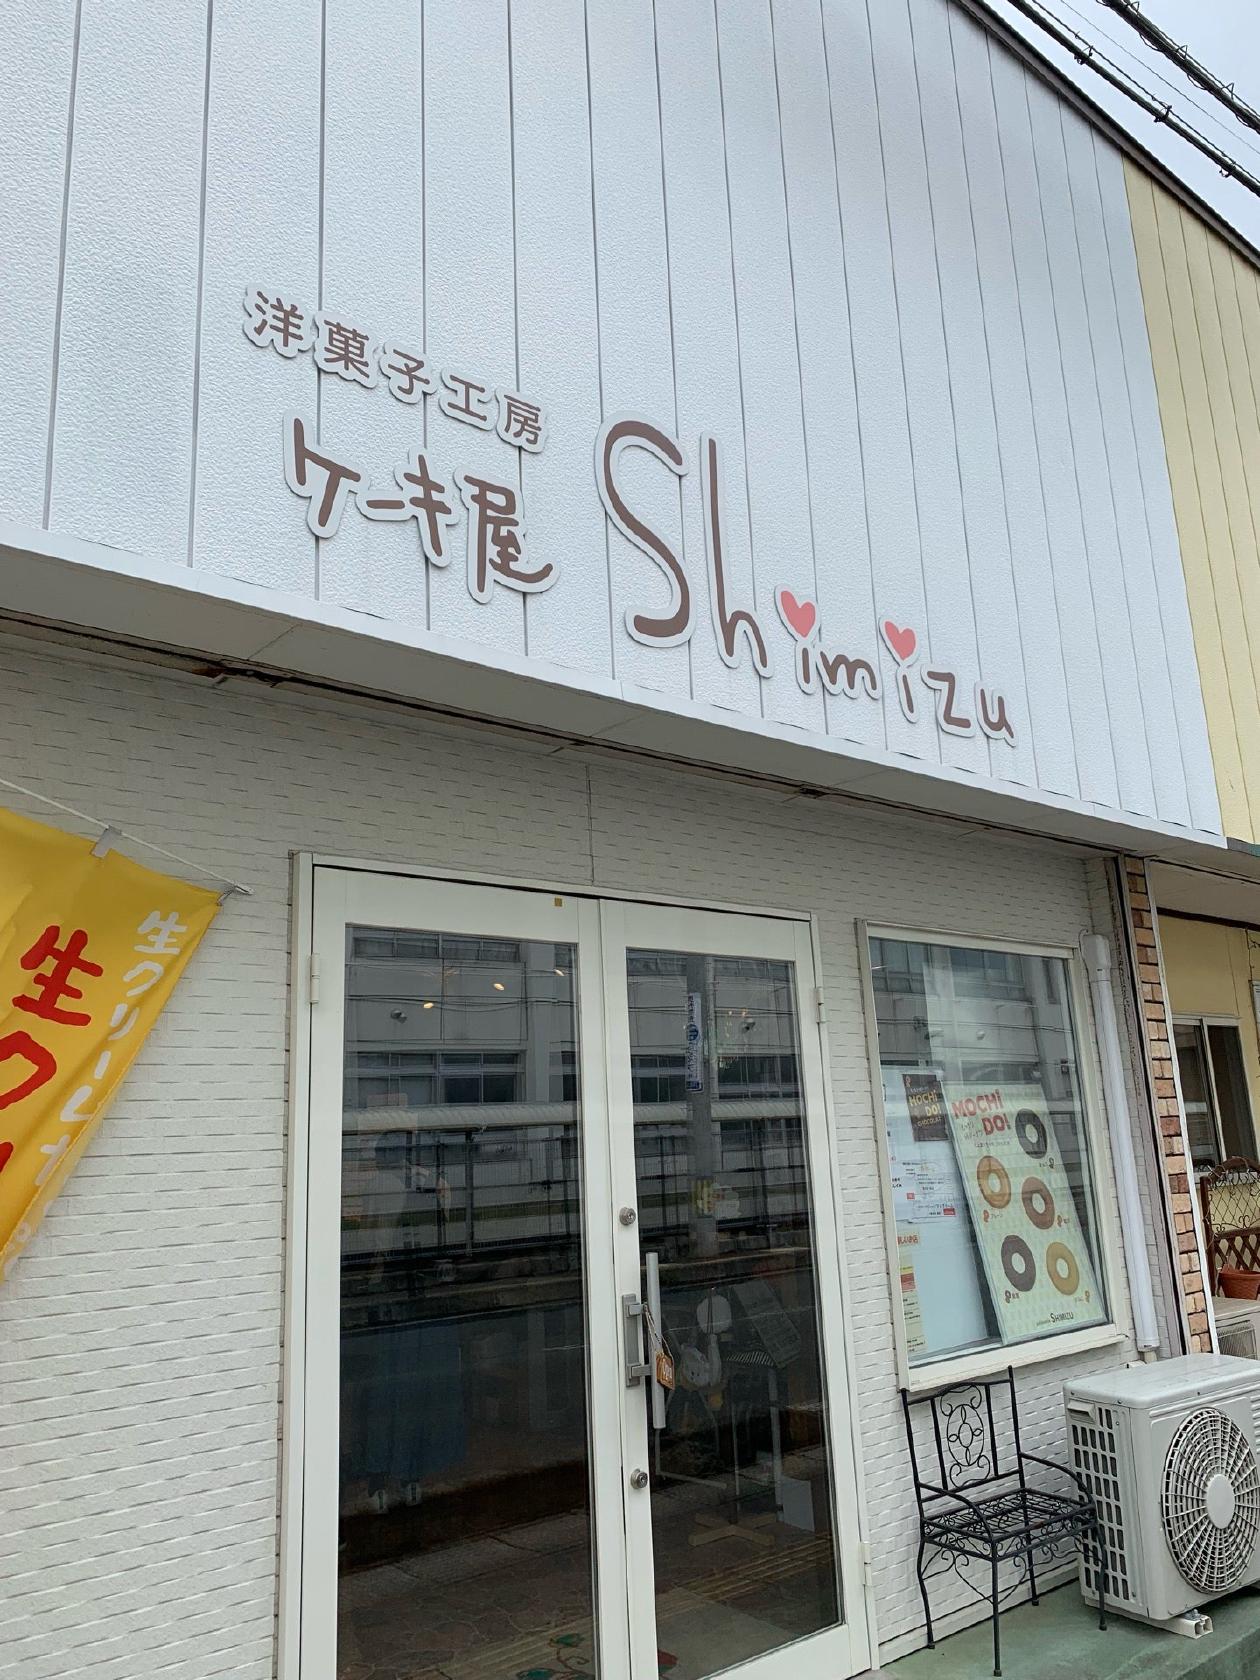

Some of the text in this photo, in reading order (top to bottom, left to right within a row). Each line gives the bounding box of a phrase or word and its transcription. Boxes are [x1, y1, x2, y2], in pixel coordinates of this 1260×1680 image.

[255, 290, 542, 446] 洋菓子工房
[293, 417, 554, 594] ケーキ屋
[603, 420, 1015, 738] Shimizu
